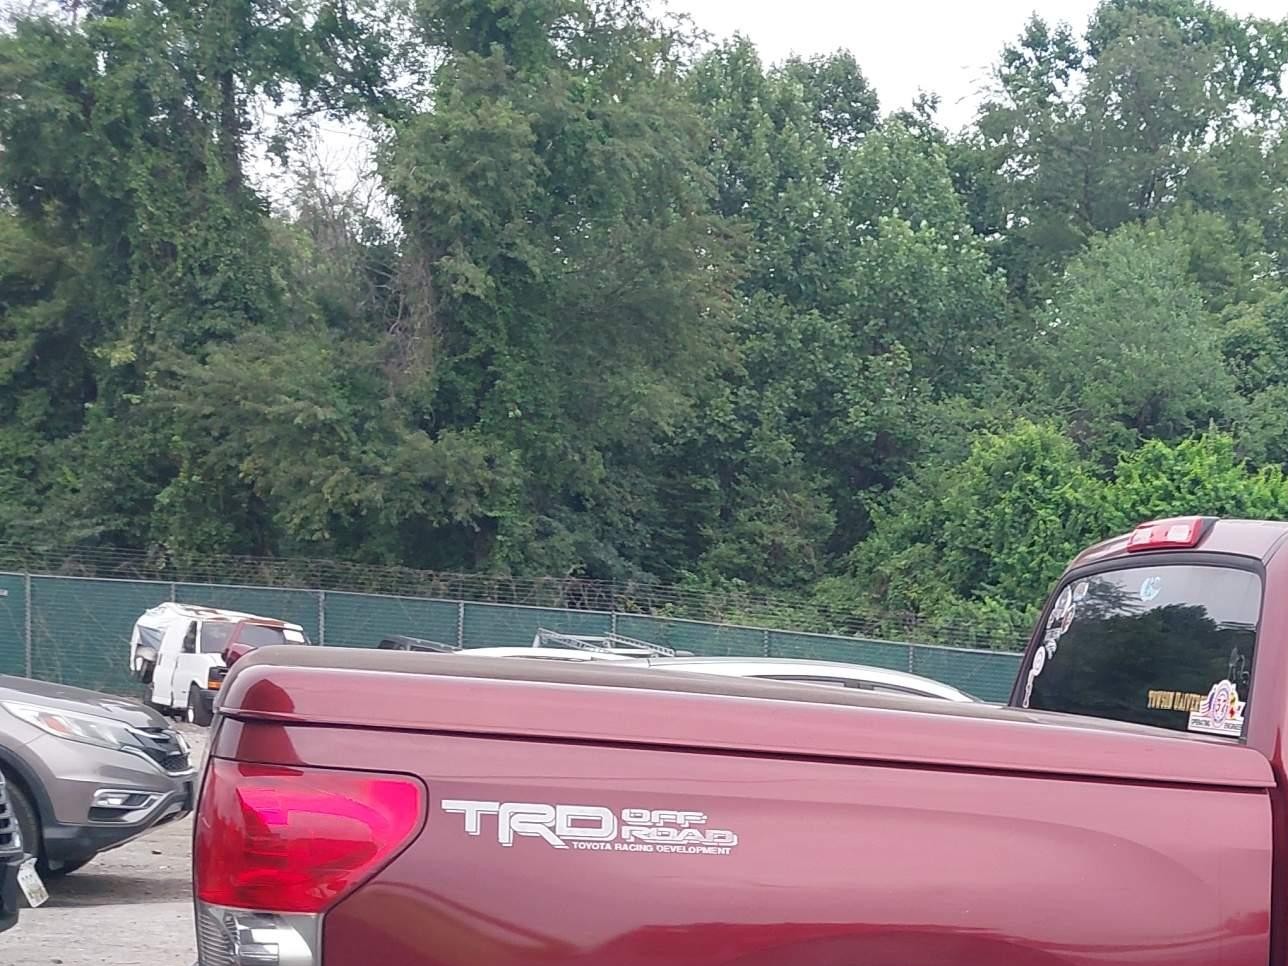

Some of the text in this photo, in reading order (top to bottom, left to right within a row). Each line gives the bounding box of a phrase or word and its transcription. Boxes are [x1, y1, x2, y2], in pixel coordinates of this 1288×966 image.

[441, 799, 618, 849] TRD
[621, 808, 708, 826] OFF
[621, 825, 738, 847] ROAD
[572, 841, 732, 855] TOYOTA RACING DEVELOPMENT
